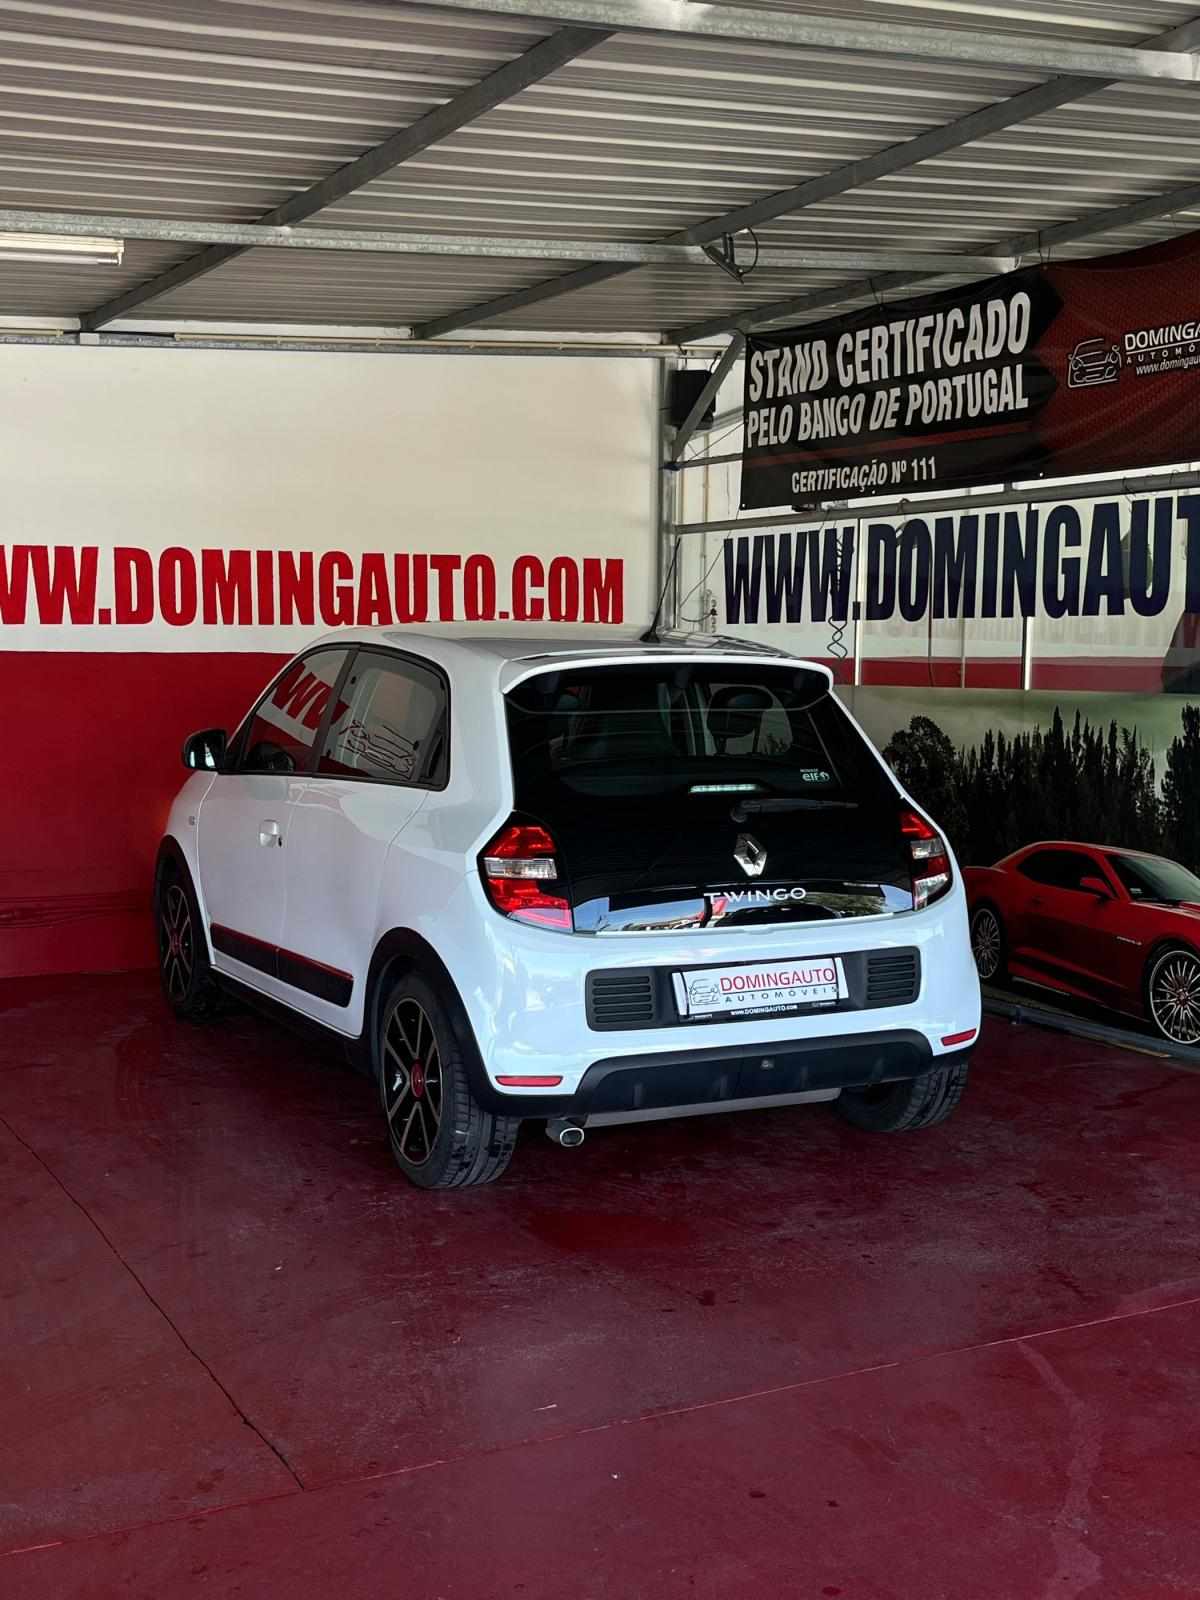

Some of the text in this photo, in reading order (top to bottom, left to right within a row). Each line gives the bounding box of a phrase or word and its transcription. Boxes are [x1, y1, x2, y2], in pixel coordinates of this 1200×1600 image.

[750, 291, 1031, 403] STAND CERTIFICADO
[747, 363, 1029, 449] PELO BANCO DE PORTUGAL
[791, 459, 888, 493] CERTIFICAÇÃO
[911, 456, 936, 481] 111
[703, 887, 807, 905] TWINGO
[720, 967, 835, 992] DOMINGAUTO
